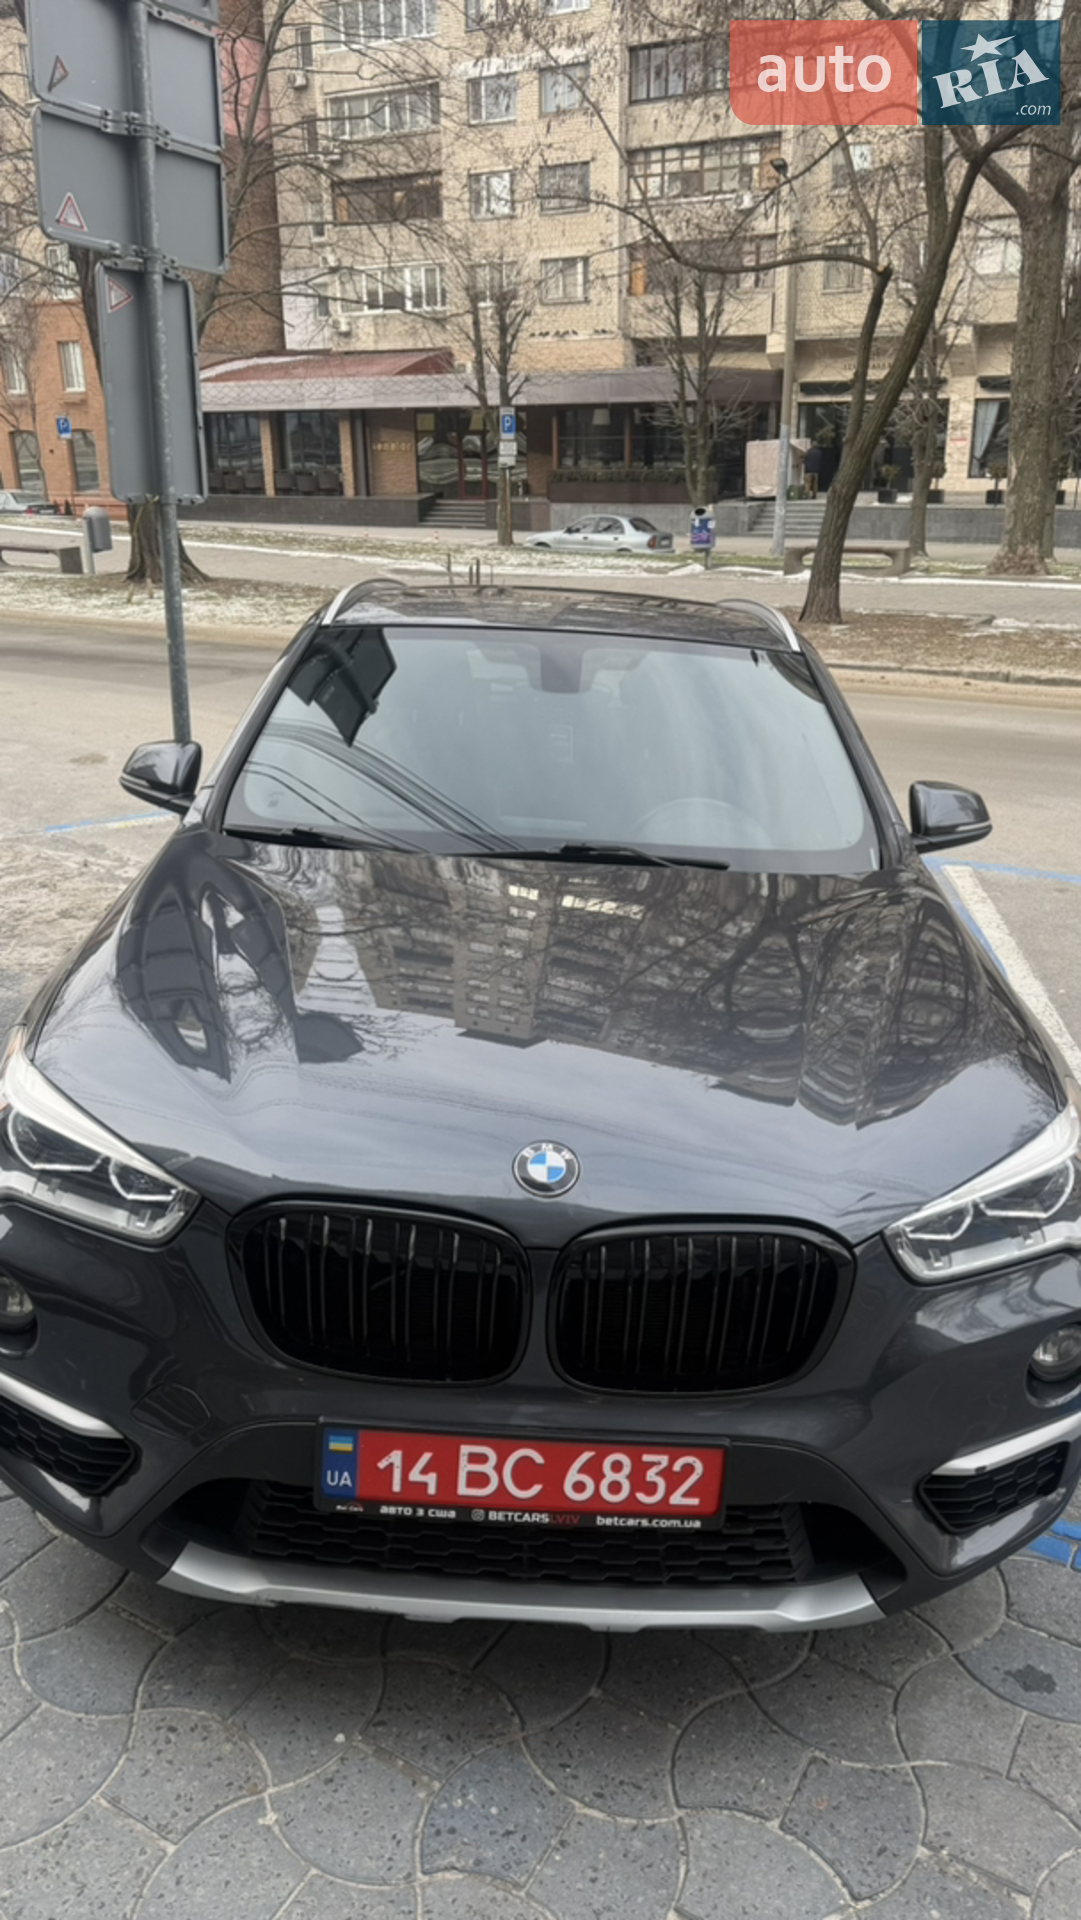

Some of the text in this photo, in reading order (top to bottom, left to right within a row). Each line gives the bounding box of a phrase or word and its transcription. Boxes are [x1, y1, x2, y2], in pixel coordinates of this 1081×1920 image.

[326, 1469, 353, 1487] UA
[376, 1444, 704, 1506] 14 BC 6832
[596, 1515, 702, 1529] betcars.com.ua
